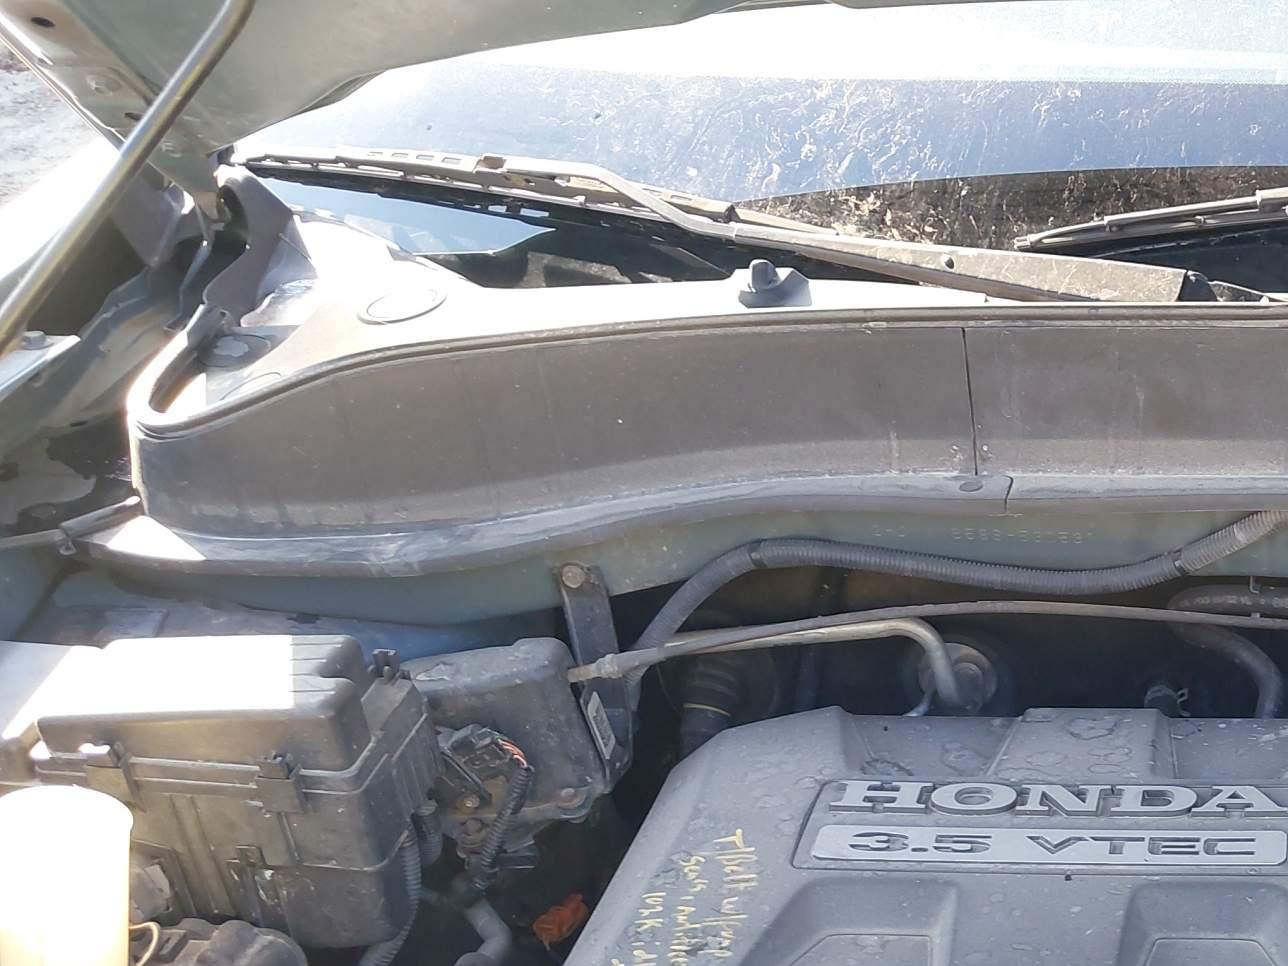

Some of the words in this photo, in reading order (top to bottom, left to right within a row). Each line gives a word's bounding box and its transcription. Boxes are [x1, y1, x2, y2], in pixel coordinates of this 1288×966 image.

[829, 780, 1288, 818] HONDA
[847, 831, 993, 855] 3.5
[1025, 834, 1257, 856] VTEC
